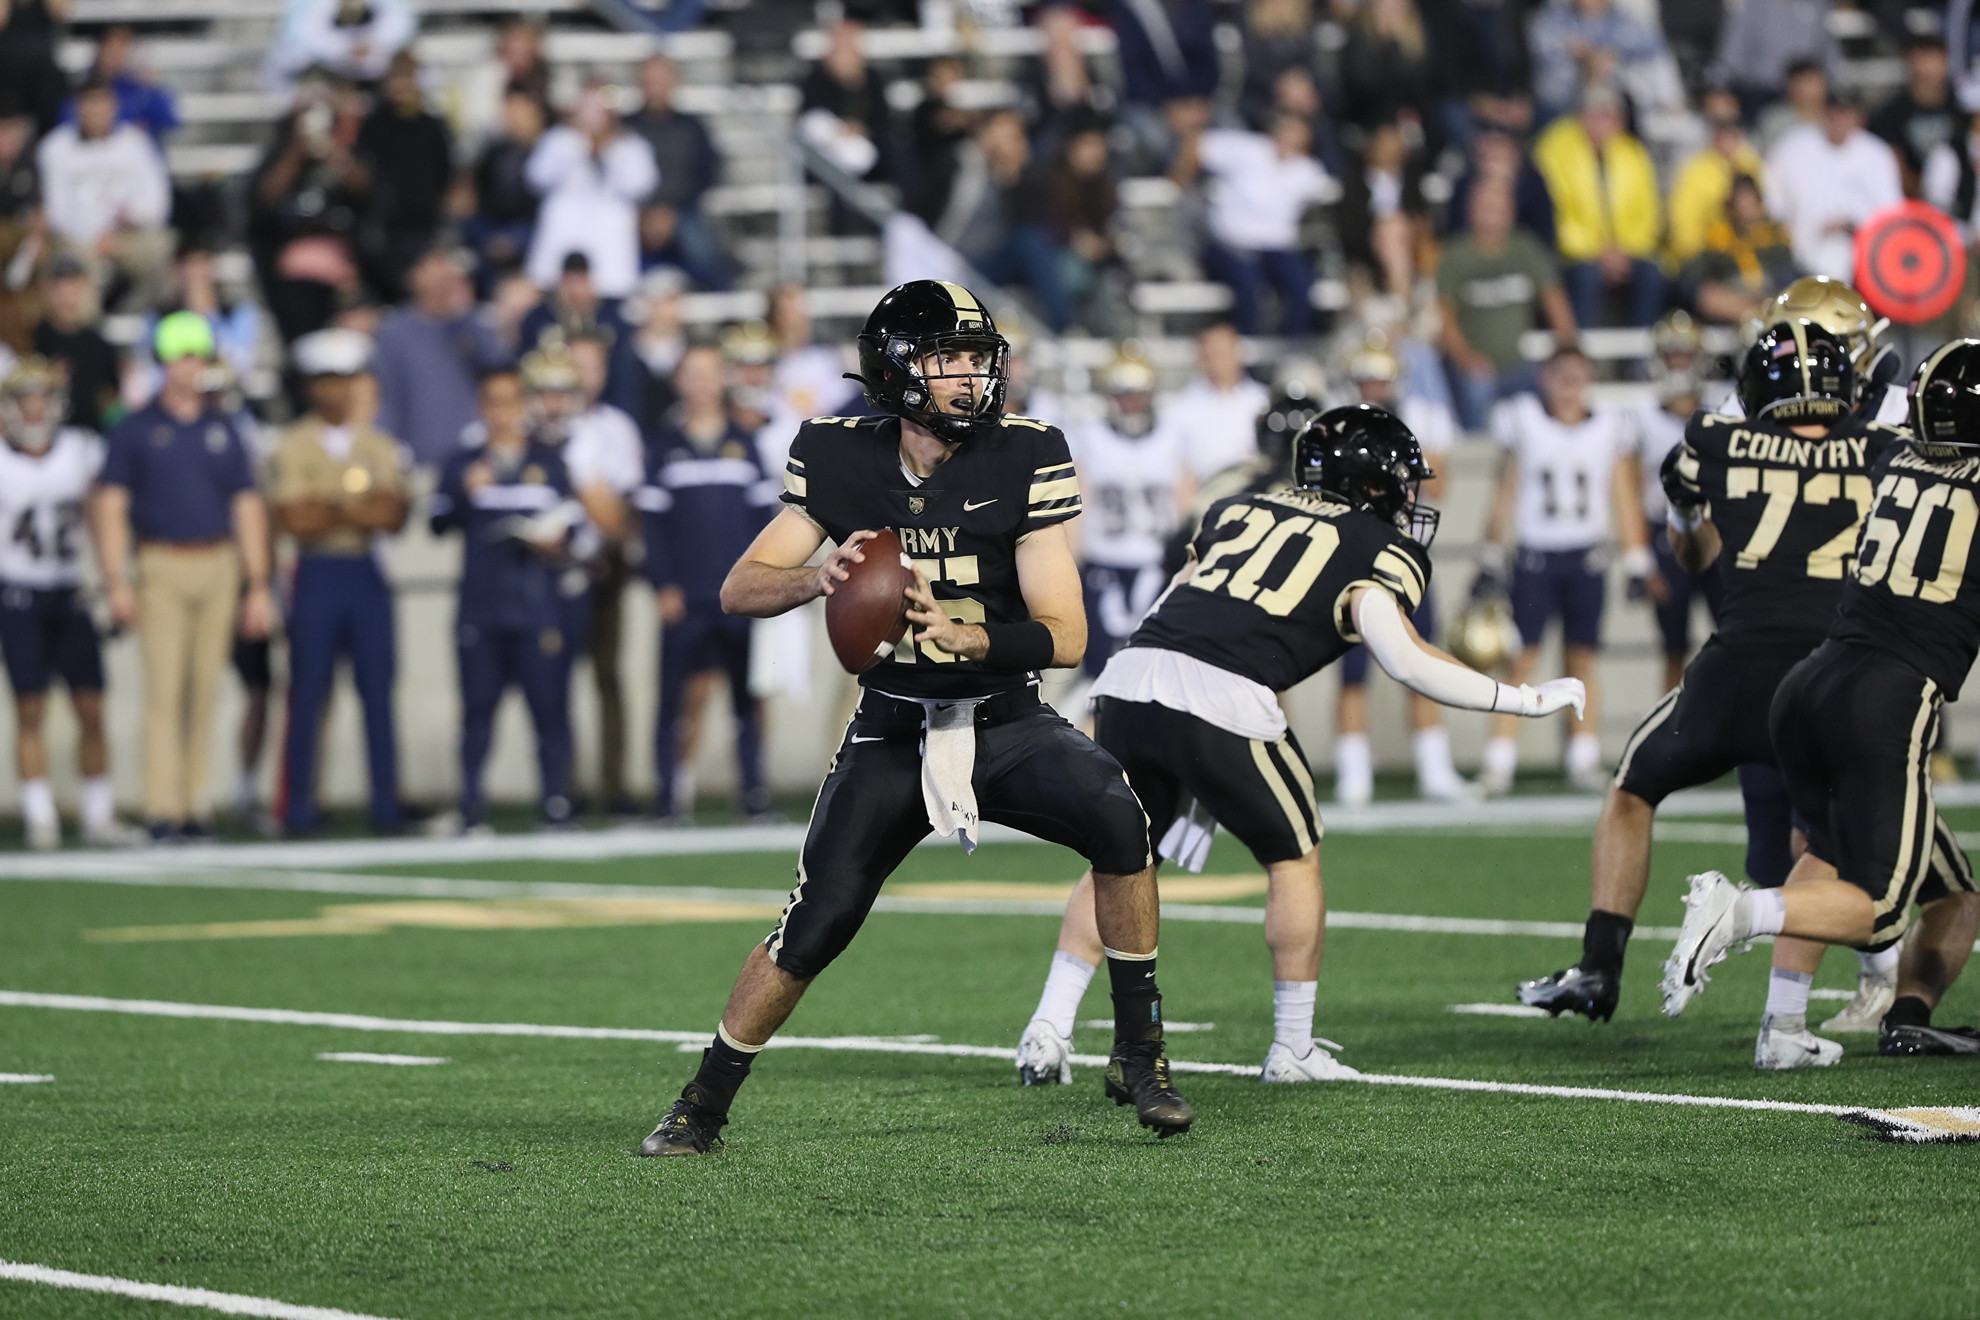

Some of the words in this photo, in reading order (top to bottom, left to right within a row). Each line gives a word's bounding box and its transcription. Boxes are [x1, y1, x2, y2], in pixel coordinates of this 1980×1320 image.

[1726, 428, 1868, 468] COUNTRY
[1773, 401, 1805, 419] WEST
[1807, 400, 1840, 415] POINT
[1537, 466, 1589, 520] 11
[1726, 467, 1875, 580] 72
[885, 526, 960, 554] RMY
[1189, 503, 1341, 616] 20
[1852, 474, 1980, 604] 60
[894, 555, 986, 664] 5
